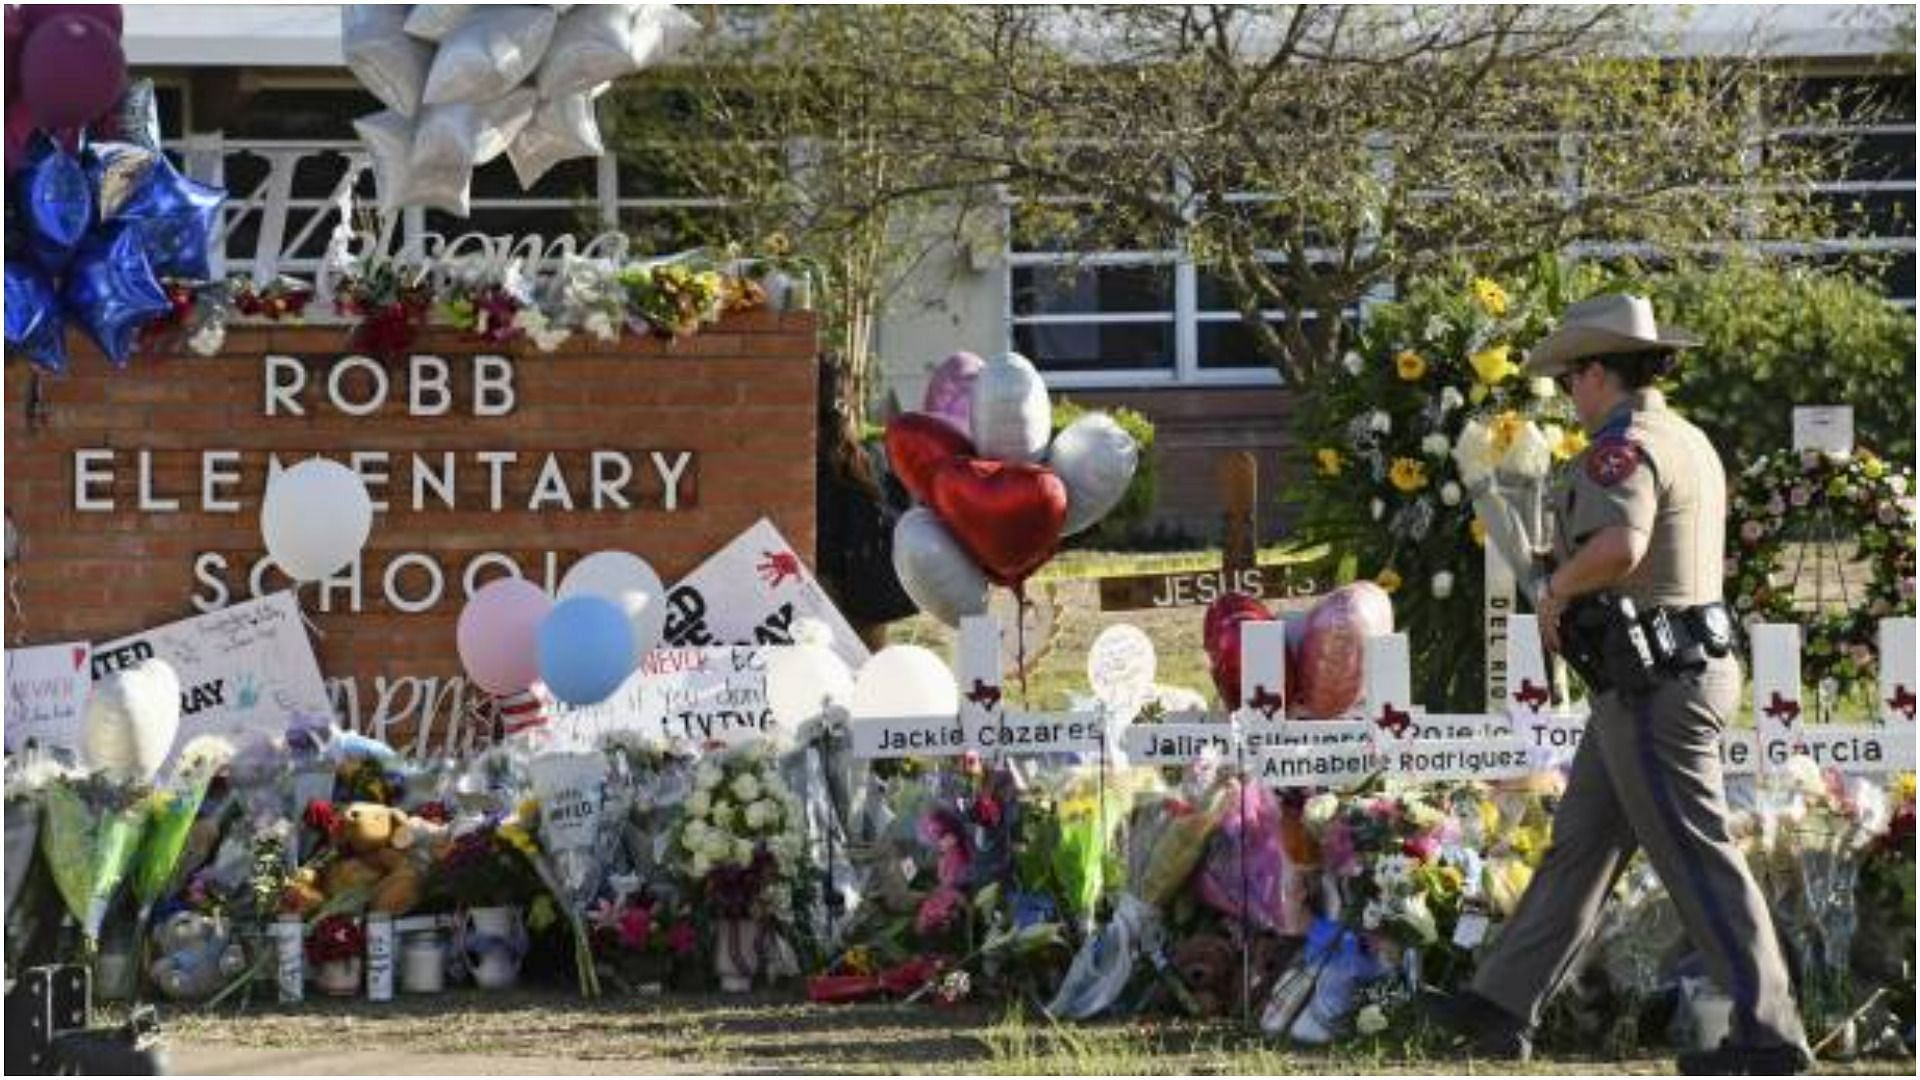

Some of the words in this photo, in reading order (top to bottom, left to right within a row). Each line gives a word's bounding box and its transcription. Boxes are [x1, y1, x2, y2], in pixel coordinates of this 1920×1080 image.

[266, 355, 515, 416] ROBB
[75, 451, 692, 510] ELEENTARY
[1153, 568, 1264, 606] JESUS
[1490, 598, 1508, 646] DEL
[1490, 660, 1508, 700] RIO
[878, 727, 964, 749] Jackie
[1400, 750, 1528, 773] Rodriguez
